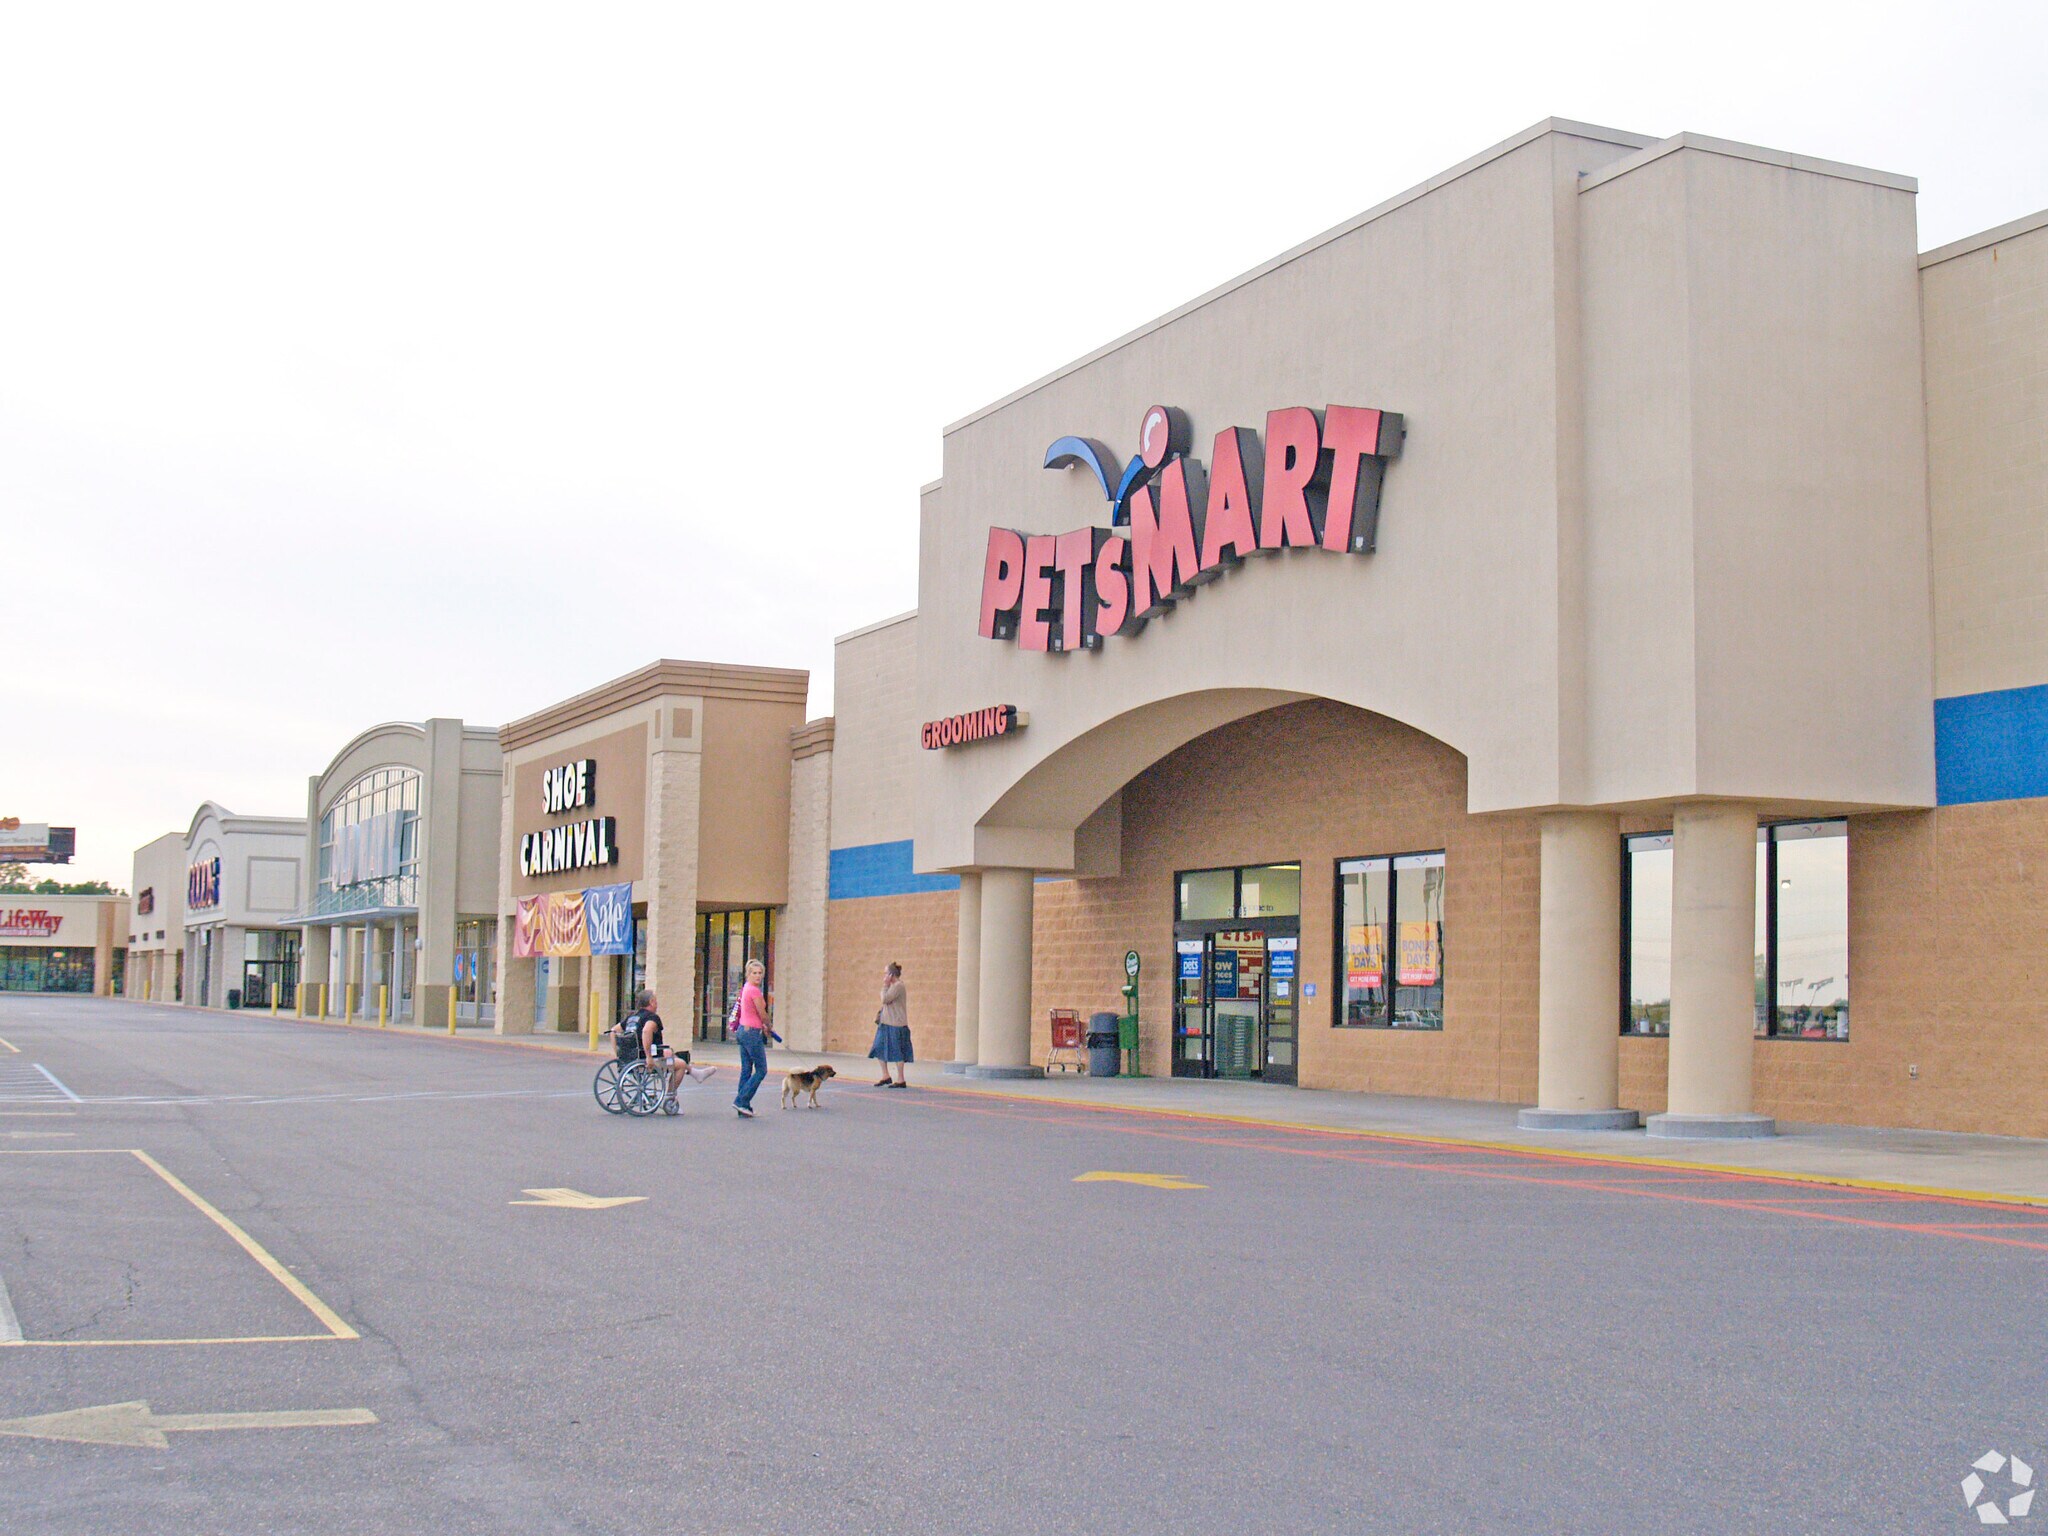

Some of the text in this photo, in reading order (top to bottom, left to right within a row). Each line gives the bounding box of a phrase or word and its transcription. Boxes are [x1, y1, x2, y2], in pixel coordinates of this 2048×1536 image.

[978, 404, 1384, 652] PETSMART
[922, 704, 1008, 750] GROOMING
[542, 759, 590, 815] SHOE
[520, 816, 611, 877] CARNIVAL
[1354, 956, 1377, 968] DAYS
[1402, 940, 1435, 952] BONUS
[1407, 953, 1430, 966] DAYS
